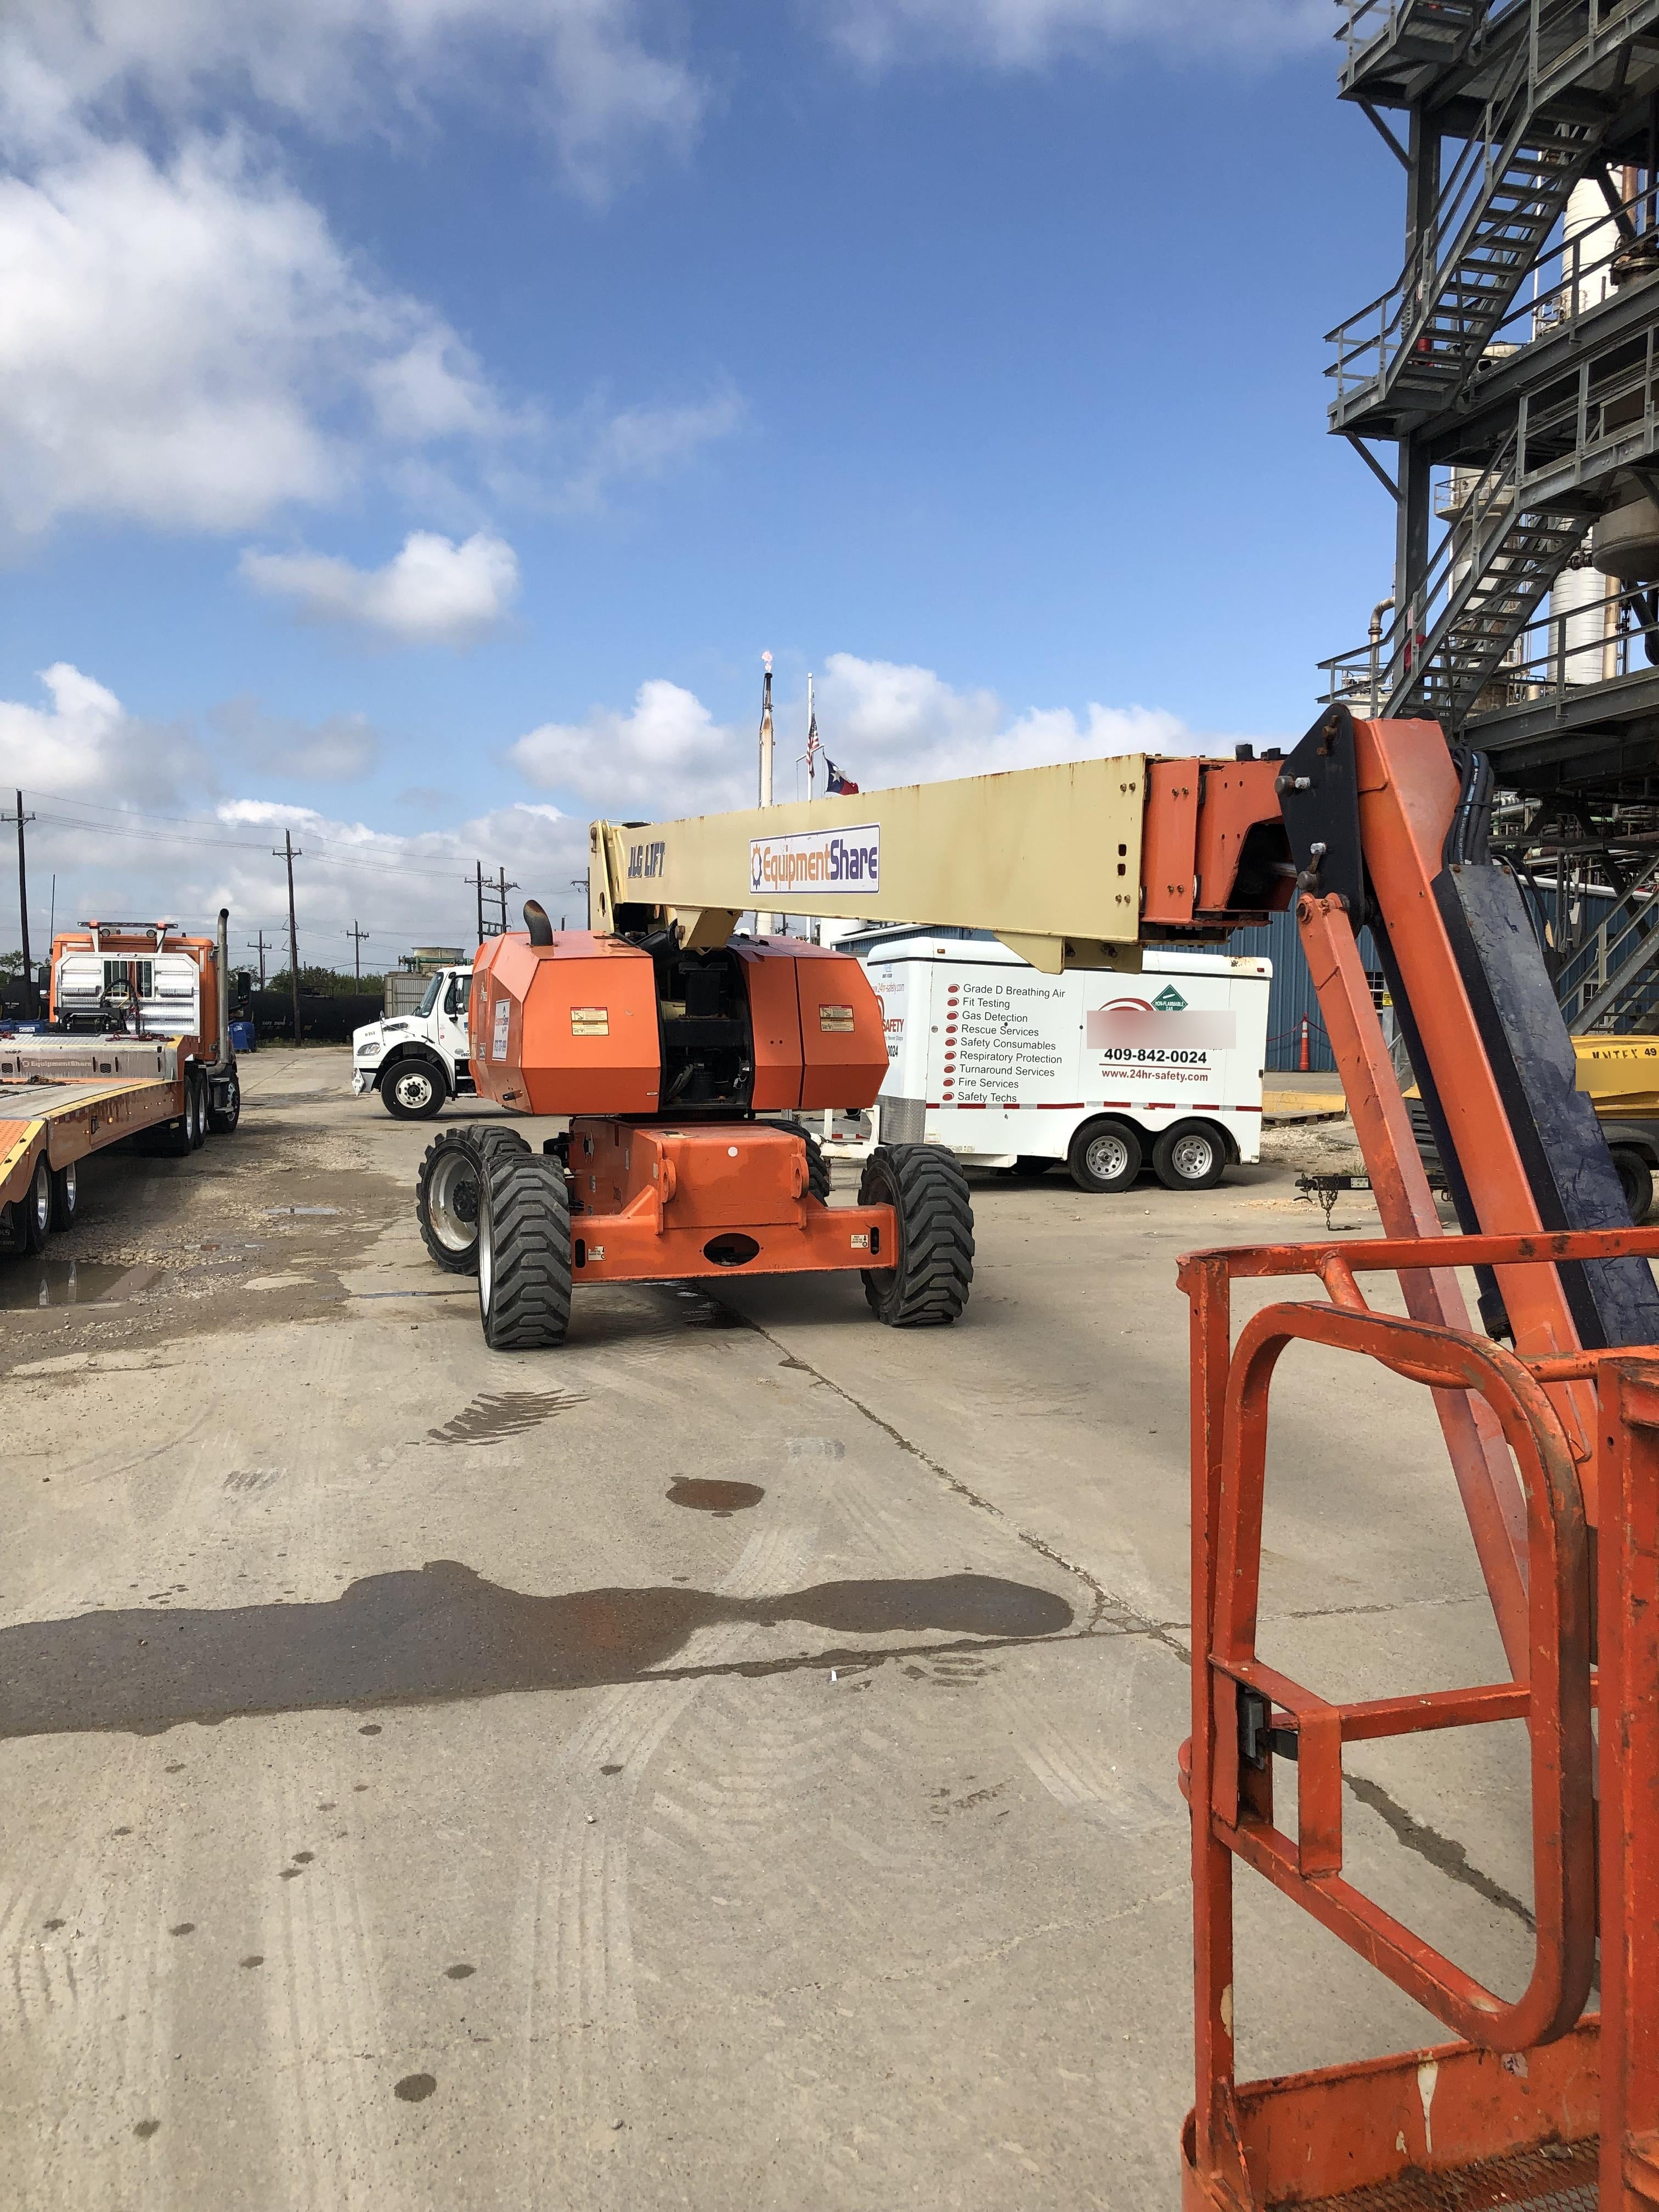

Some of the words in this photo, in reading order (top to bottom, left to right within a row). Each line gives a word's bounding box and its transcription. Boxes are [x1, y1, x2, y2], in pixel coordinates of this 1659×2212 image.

[627, 845, 642, 878] JLG
[644, 841, 665, 877] LIFT
[763, 839, 877, 890] EquipmentShare
[963, 984, 992, 994] Grade
[996, 985, 1003, 994] D
[1006, 986, 1050, 999] Breathing
[1052, 989, 1065, 997] Air
[963, 997, 974, 1006] Fit
[978, 998, 1010, 1010] Testing
[962, 1011, 981, 1020] Gas
[985, 1012, 1028, 1022] Detection
[882, 1019, 904, 1032] SAFETY
[962, 1024, 996, 1034] Rescue
[1000, 1026, 1039, 1036] Services
[961, 1037, 990, 1049] Safety
[994, 1039, 1056, 1050] Consumables
[960, 1051, 1013, 1063] Respiratory
[1016, 1053, 1062, 1063] Protection
[1104, 1049, 1207, 1063] 409-842-0024
[960, 1064, 1012, 1075] Turnaround
[1015, 1066, 1055, 1076] Services
[1102, 1069, 1208, 1082] www.24hr-safety.com
[958, 1077, 977, 1086] Fire
[980, 1078, 1019, 1088] Services
[958, 1092, 988, 1103] Safety
[990, 1093, 1017, 1102] Techs
